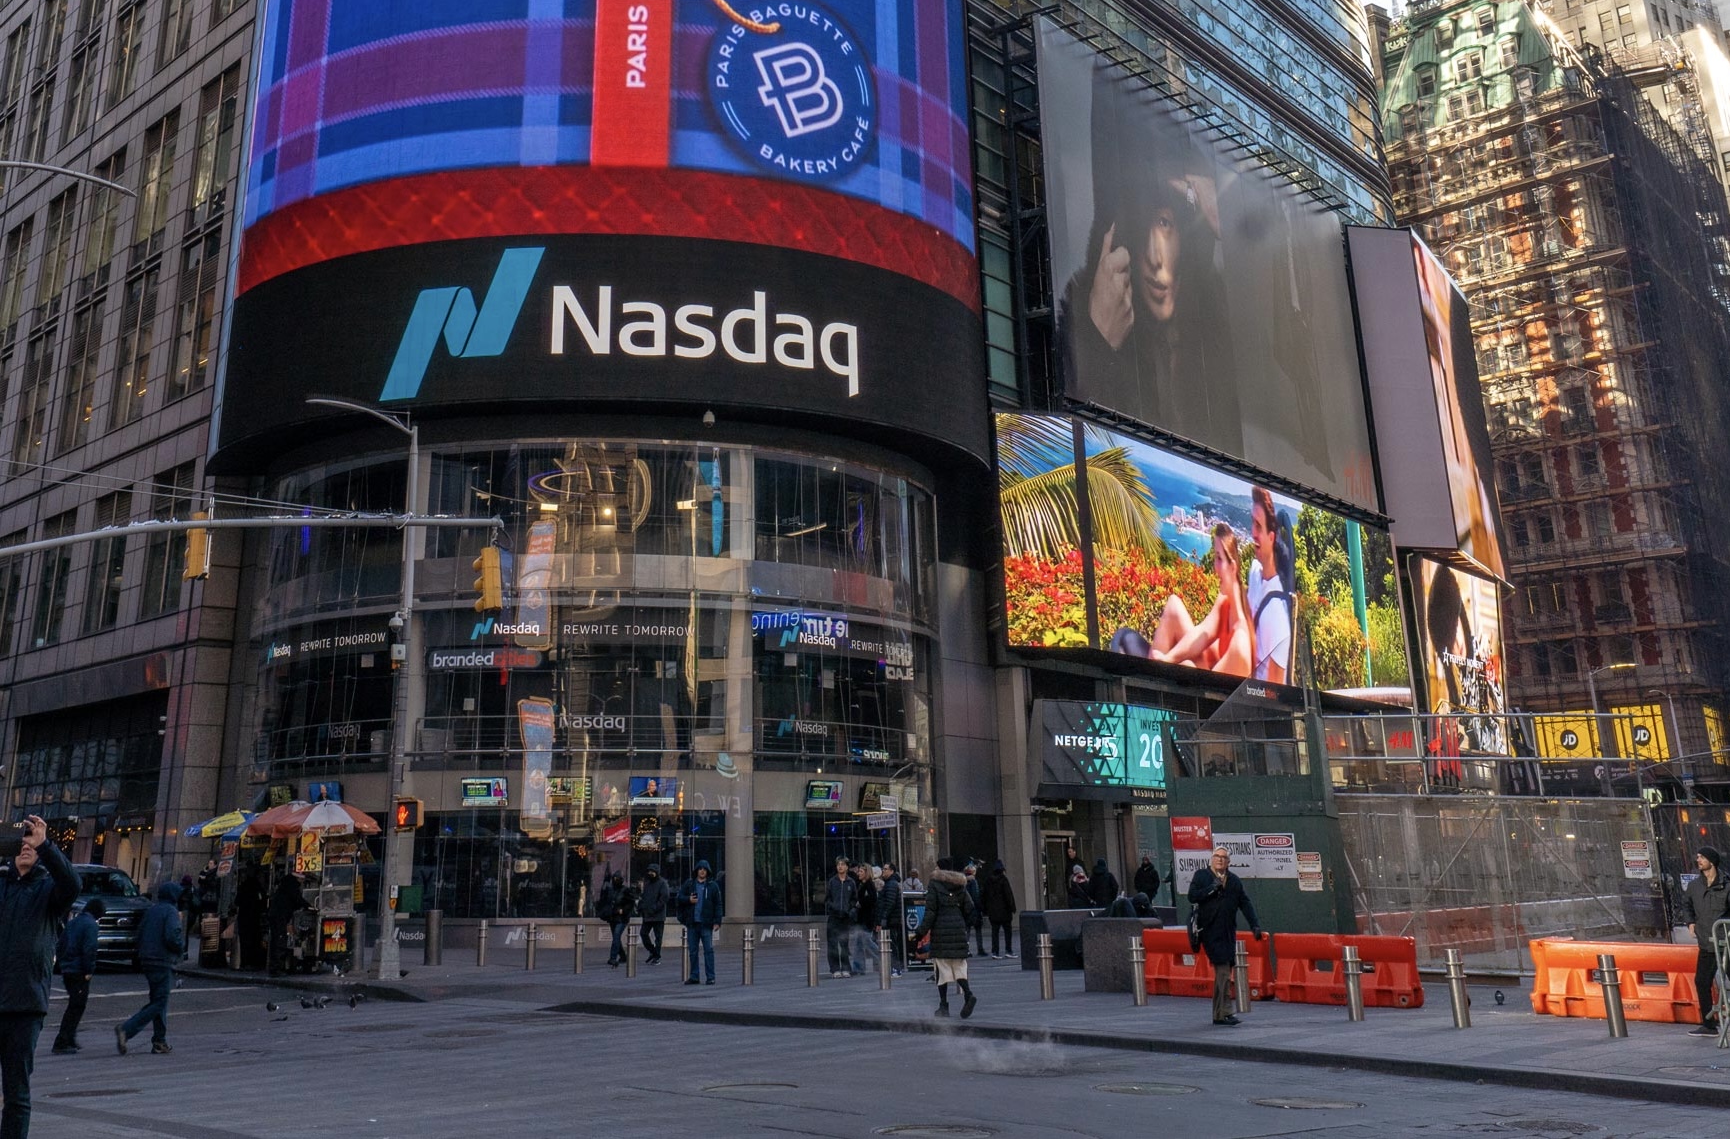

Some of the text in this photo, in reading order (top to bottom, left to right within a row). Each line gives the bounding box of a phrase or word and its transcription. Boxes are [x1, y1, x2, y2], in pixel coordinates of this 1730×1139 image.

[626, 5, 648, 88] PARIS
[716, 3, 853, 88] PARIS BAGUETTE
[760, 115, 869, 174] BAKERY CAFÉ
[551, 285, 859, 397] Nasdaq
[493, 622, 695, 637] Nasdaq REWRITE TOMORROW
[300, 638, 331, 652] REWRITE
[335, 632, 386, 647] TOMORROW
[800, 632, 836, 649] Nasdaq
[851, 639, 883, 654] REWRITE
[328, 722, 360, 740] Nasdaq
[559, 715, 626, 733] Nasdaq
[795, 721, 827, 737] Nasdaq
[1563, 734, 1577, 746] JD
[1634, 729, 1649, 741] JD
[399, 931, 426, 941] Nasda
[521, 930, 556, 942] Ndaq
[774, 927, 802, 938] Nasdaq
